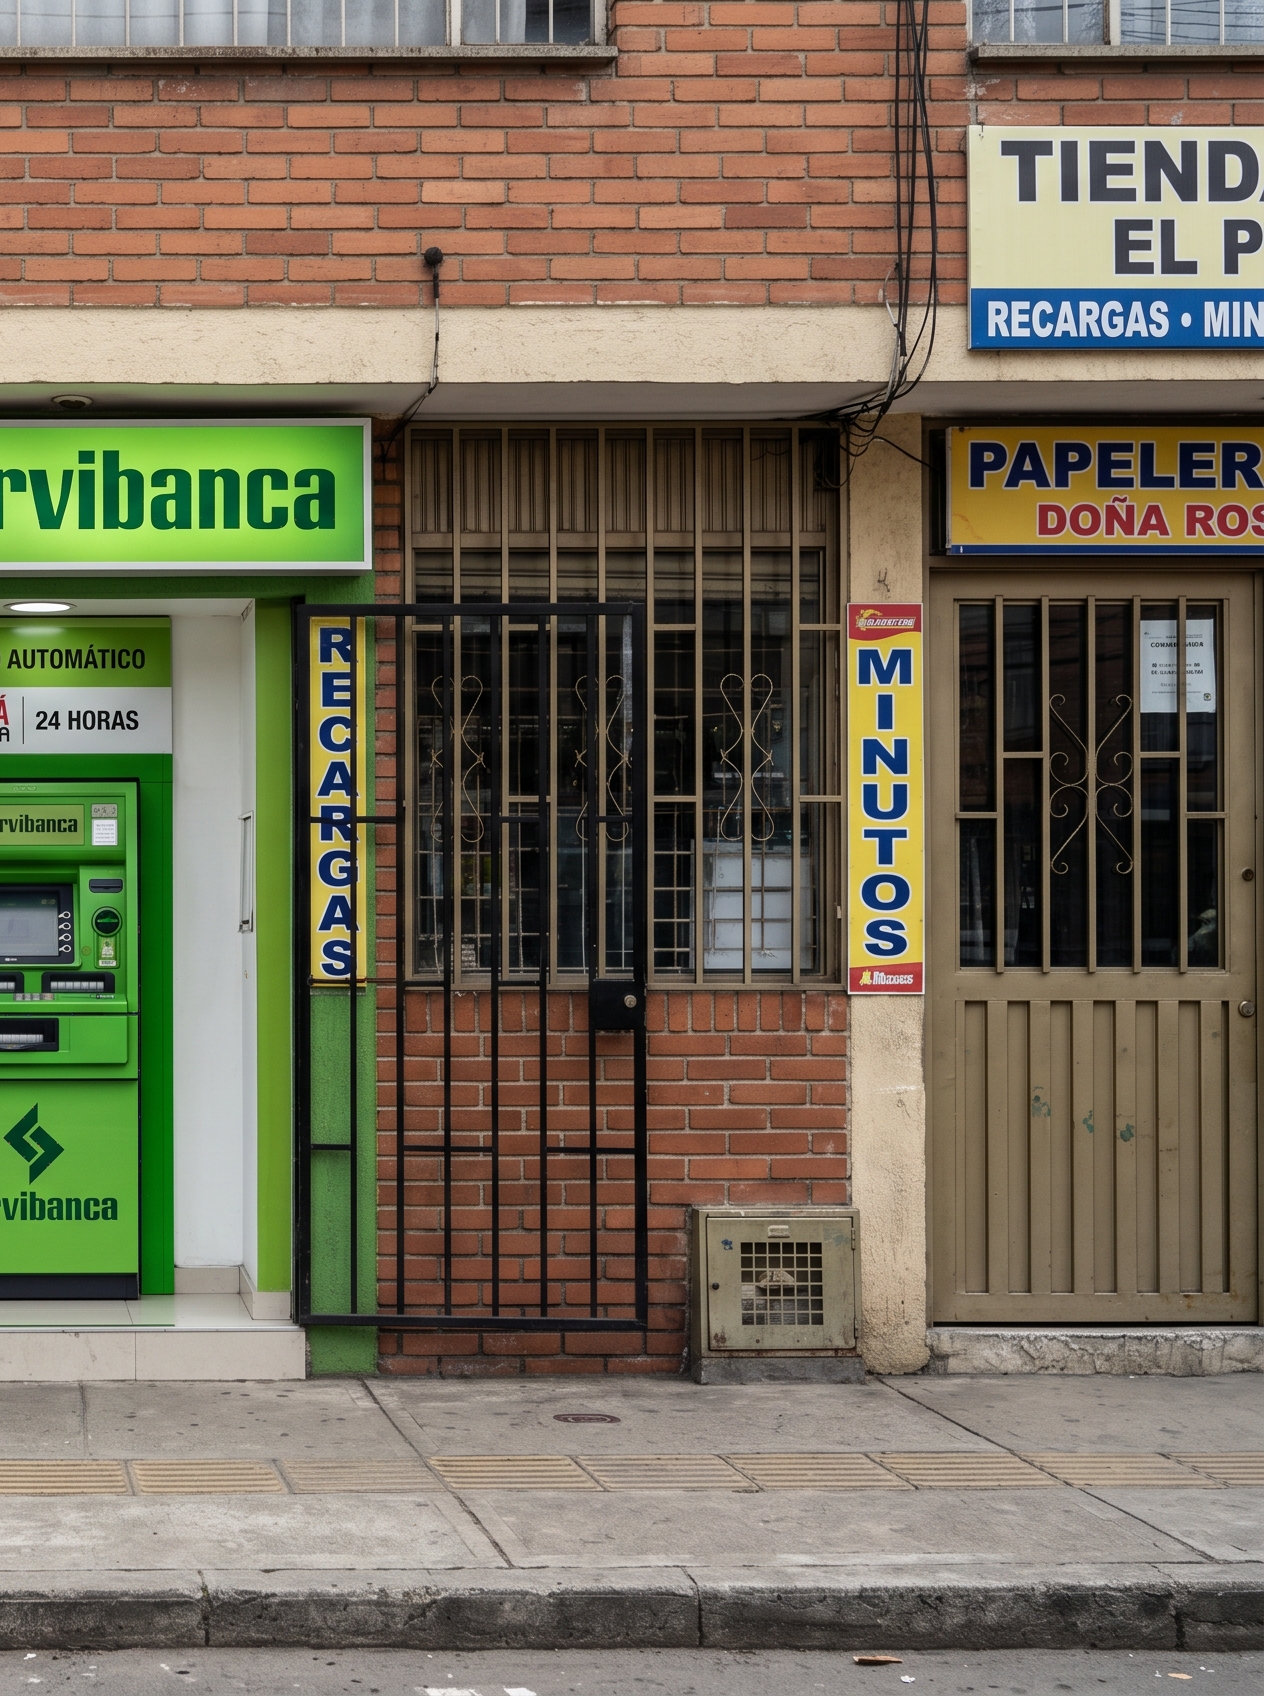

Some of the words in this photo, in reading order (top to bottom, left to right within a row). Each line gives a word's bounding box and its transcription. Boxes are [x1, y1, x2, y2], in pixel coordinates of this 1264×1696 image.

[1000, 140, 1264, 202] TIEND
[1114, 218, 1198, 275] EL
[987, 300, 1170, 338] RECARGAS
[968, 441, 1264, 489] PAPELER
[1036, 495, 1172, 537] DOÑA
[7, 644, 146, 670] AUTOMÁTICO
[35, 710, 61, 731] 24
[68, 710, 139, 731] HORAS
[316, 626, 360, 977] RECARGAS
[856, 647, 913, 958] MINUTOS
